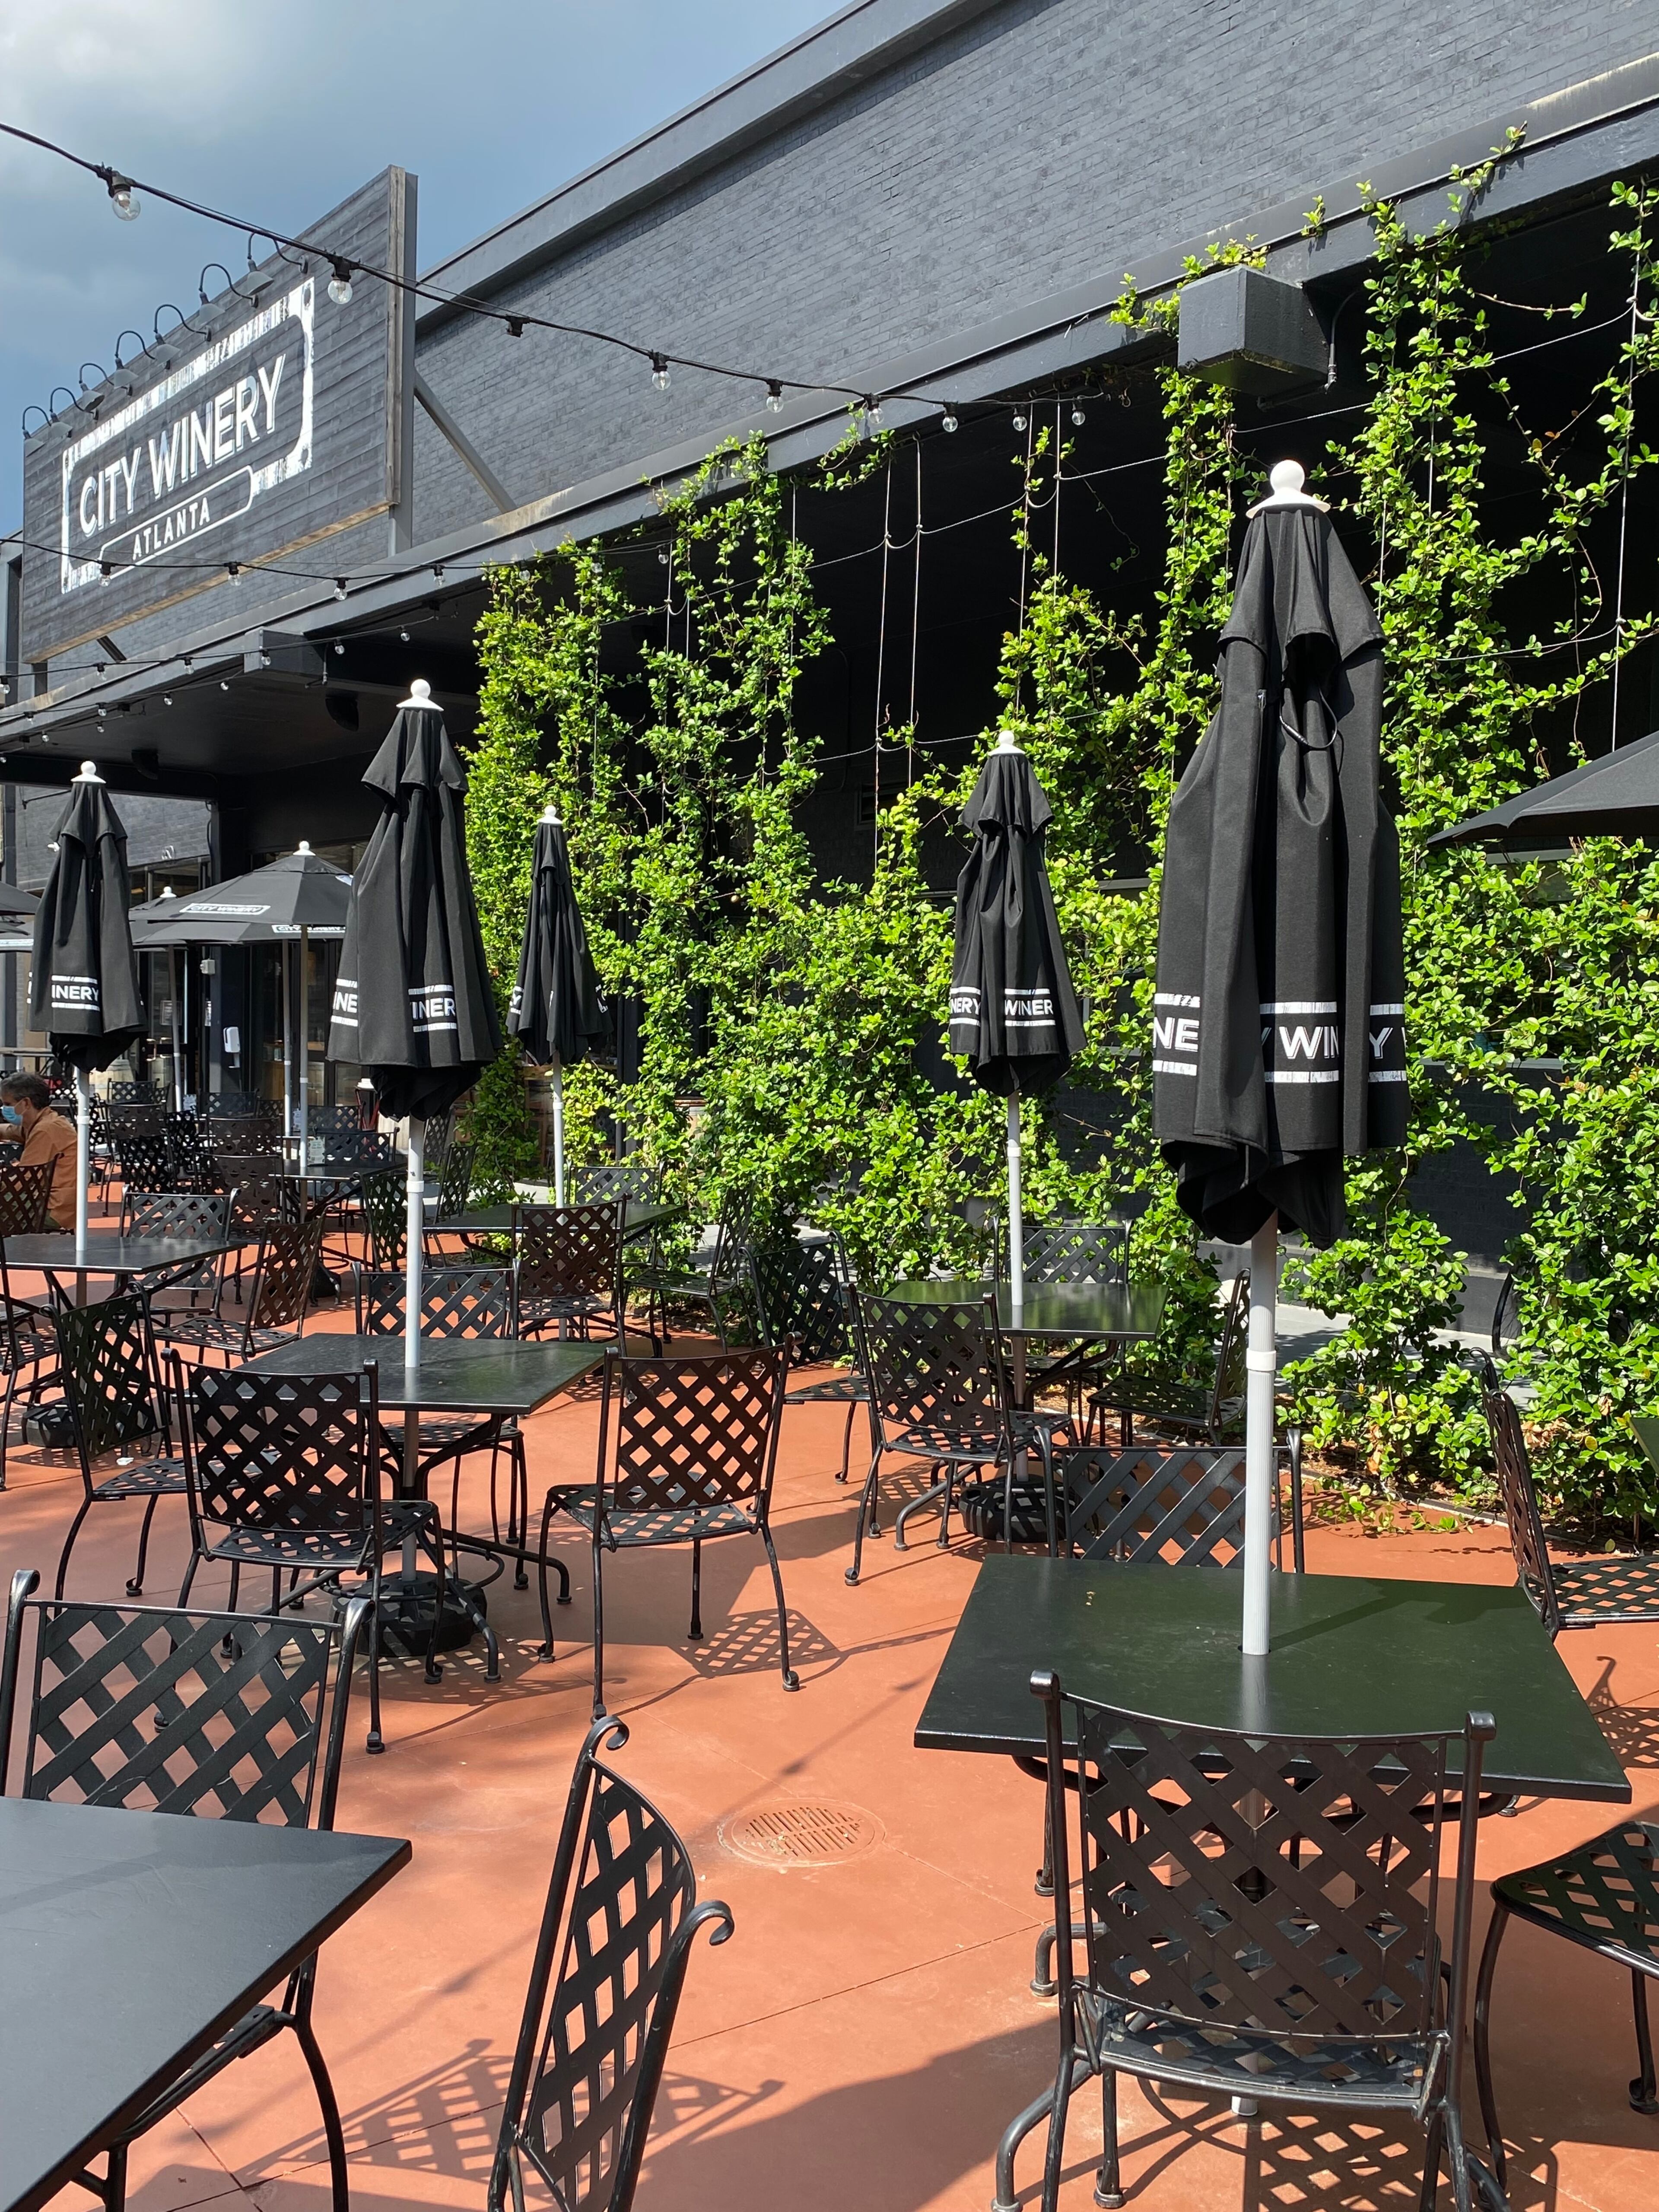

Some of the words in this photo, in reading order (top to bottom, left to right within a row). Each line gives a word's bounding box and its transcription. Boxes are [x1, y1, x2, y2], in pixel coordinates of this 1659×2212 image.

[79, 446, 142, 537] CITY
[148, 353, 286, 499] WINERY
[132, 497, 210, 561] ATLANTA
[51, 984, 99, 1001] INERY
[332, 991, 358, 1014] INE
[411, 998, 456, 1020] INER
[950, 997, 982, 1015] NERY
[1004, 999, 1054, 1016] WINER
[1278, 1025, 1340, 1059] WIN
